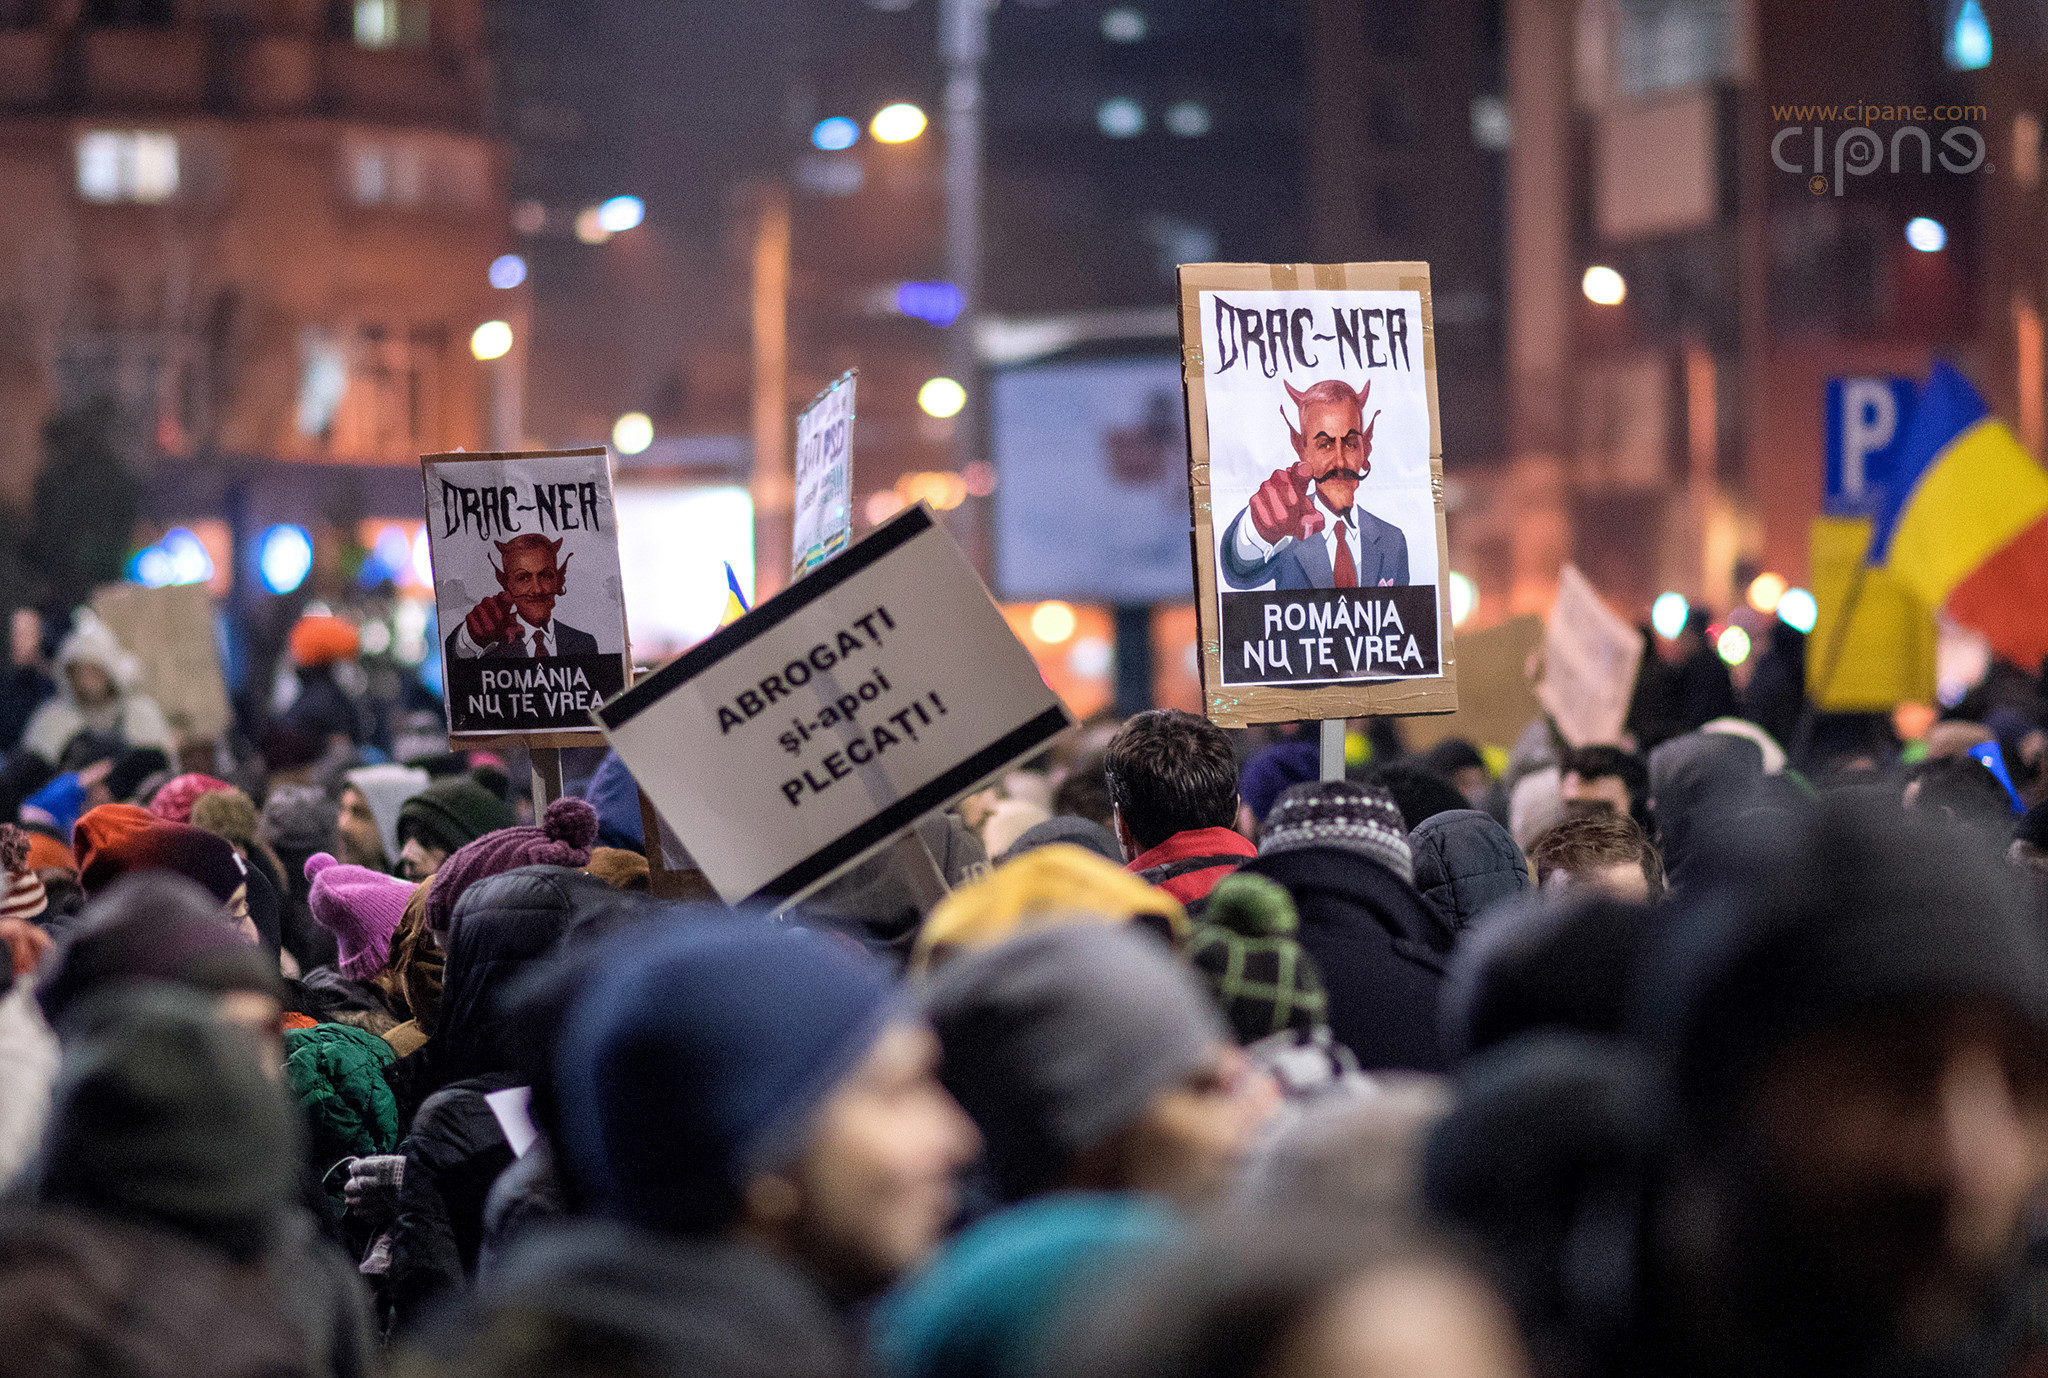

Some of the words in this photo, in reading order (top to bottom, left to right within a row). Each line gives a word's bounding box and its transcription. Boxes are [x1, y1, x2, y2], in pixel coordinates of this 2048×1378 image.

[1842, 377, 1897, 499] P
[1264, 594, 1405, 640] ROMÂNIA
[716, 605, 896, 736] ABROGAȚI
[1243, 639, 1293, 677] NU
[1299, 637, 1339, 674] TE
[1345, 634, 1425, 673] VREA
[481, 662, 591, 695] ROMÂNIA
[468, 693, 504, 719] NU
[508, 693, 539, 719] TE
[543, 690, 605, 718] VREA
